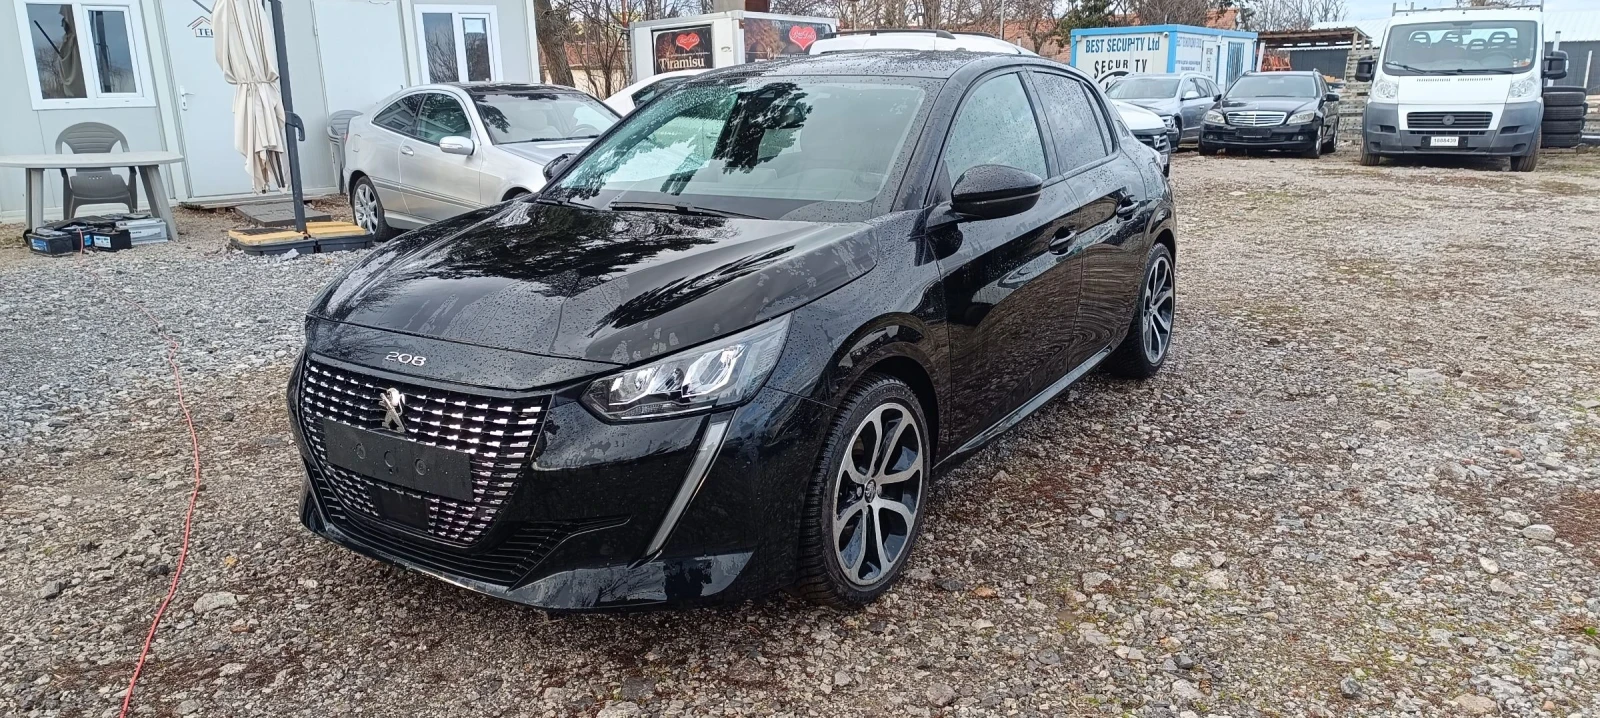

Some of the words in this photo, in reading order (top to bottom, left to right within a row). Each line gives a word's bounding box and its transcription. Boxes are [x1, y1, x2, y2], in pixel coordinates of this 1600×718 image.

[1085, 39, 1105, 53] BEST
[1148, 36, 1160, 51] Ltd
[658, 56, 705, 70] Tiramisu
[1094, 58, 1148, 79] SECURTY
[385, 352, 426, 366] 208
